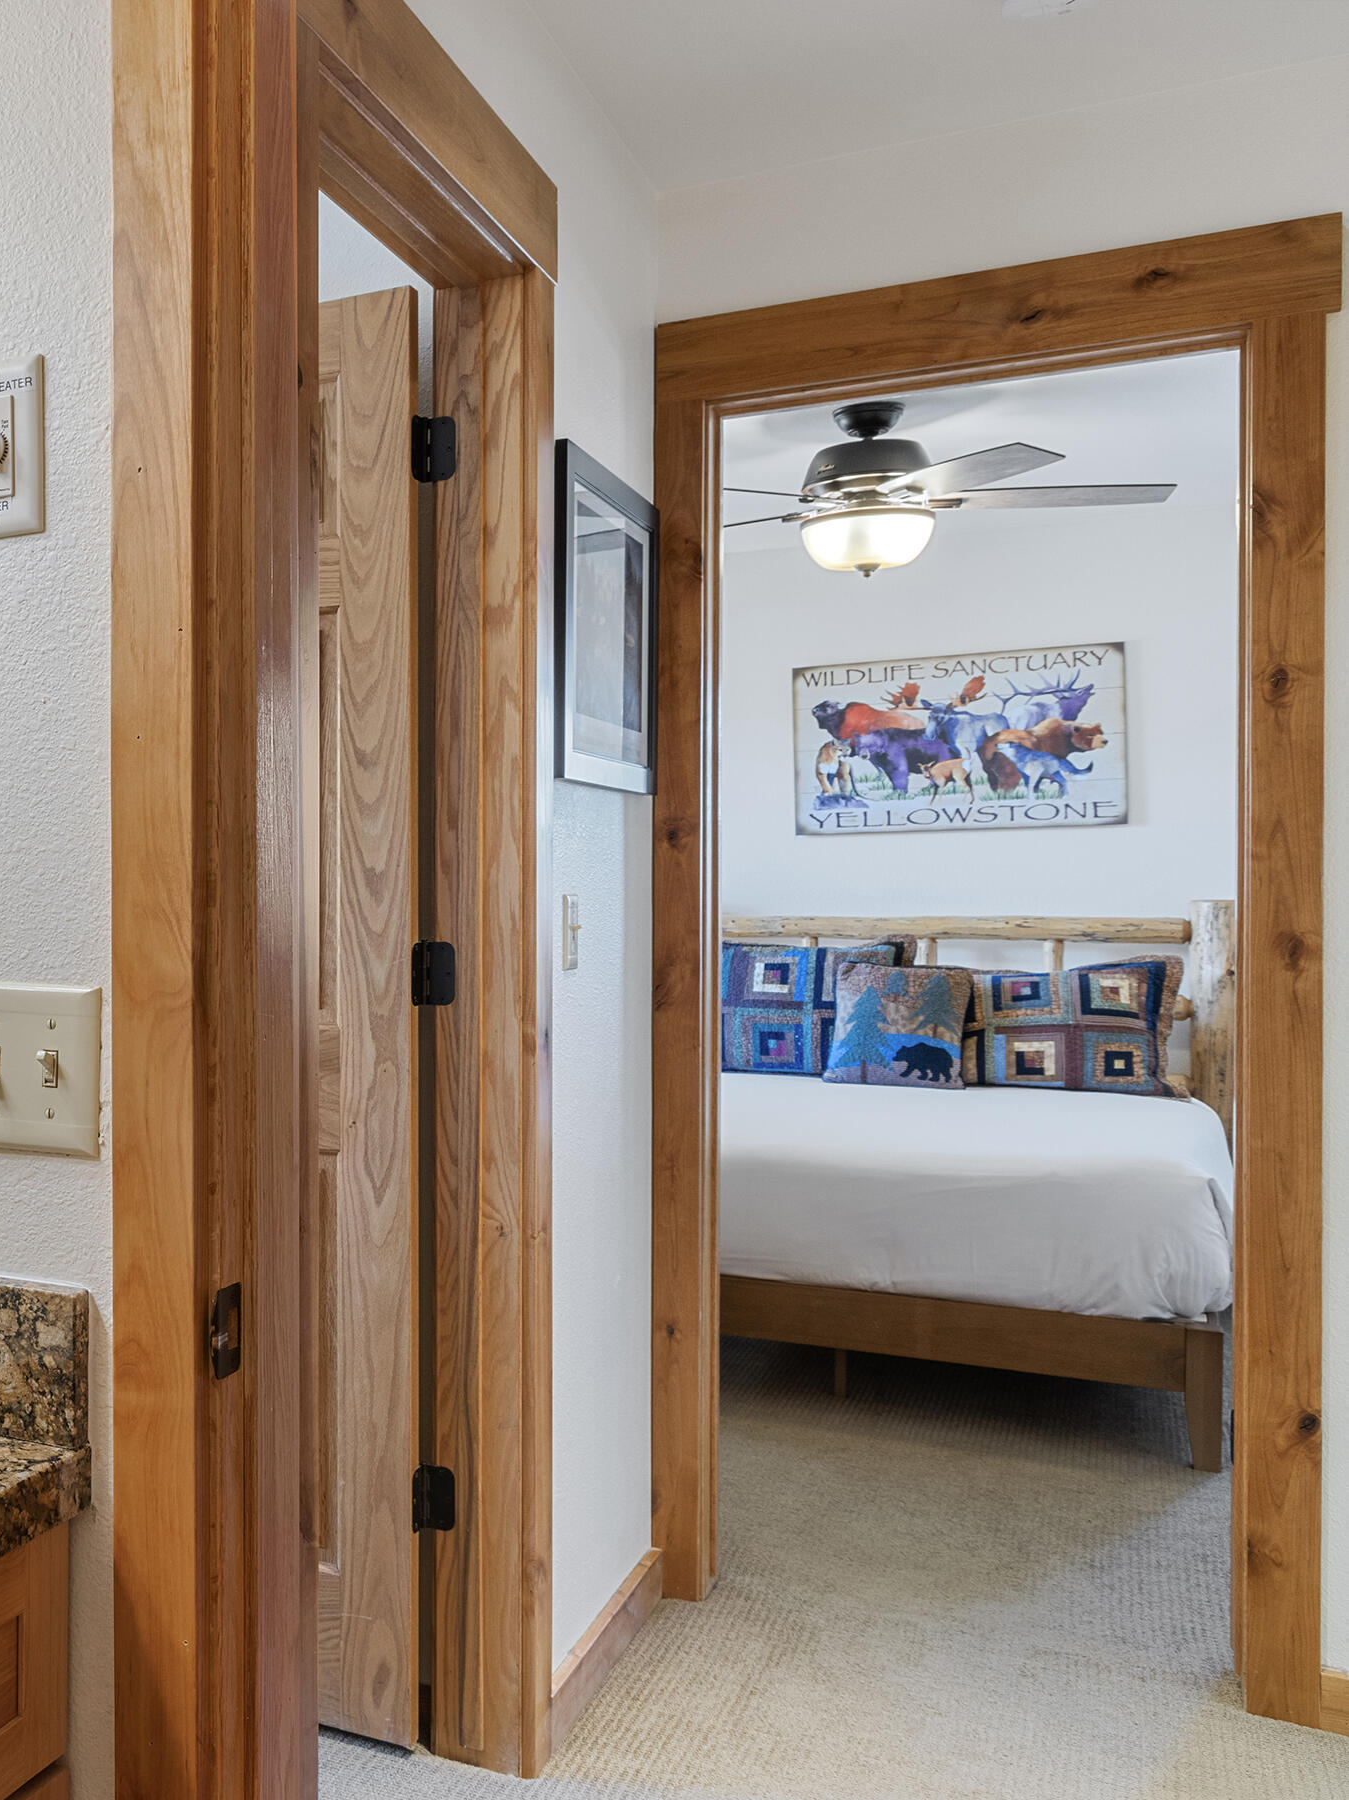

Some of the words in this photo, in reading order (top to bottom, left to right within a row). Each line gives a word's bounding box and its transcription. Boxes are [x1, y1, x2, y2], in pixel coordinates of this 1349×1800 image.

[801, 664, 926, 688] WILDLIFE
[931, 649, 1109, 679] SANCTUARY
[809, 801, 1119, 829] YELLOWSTONE
